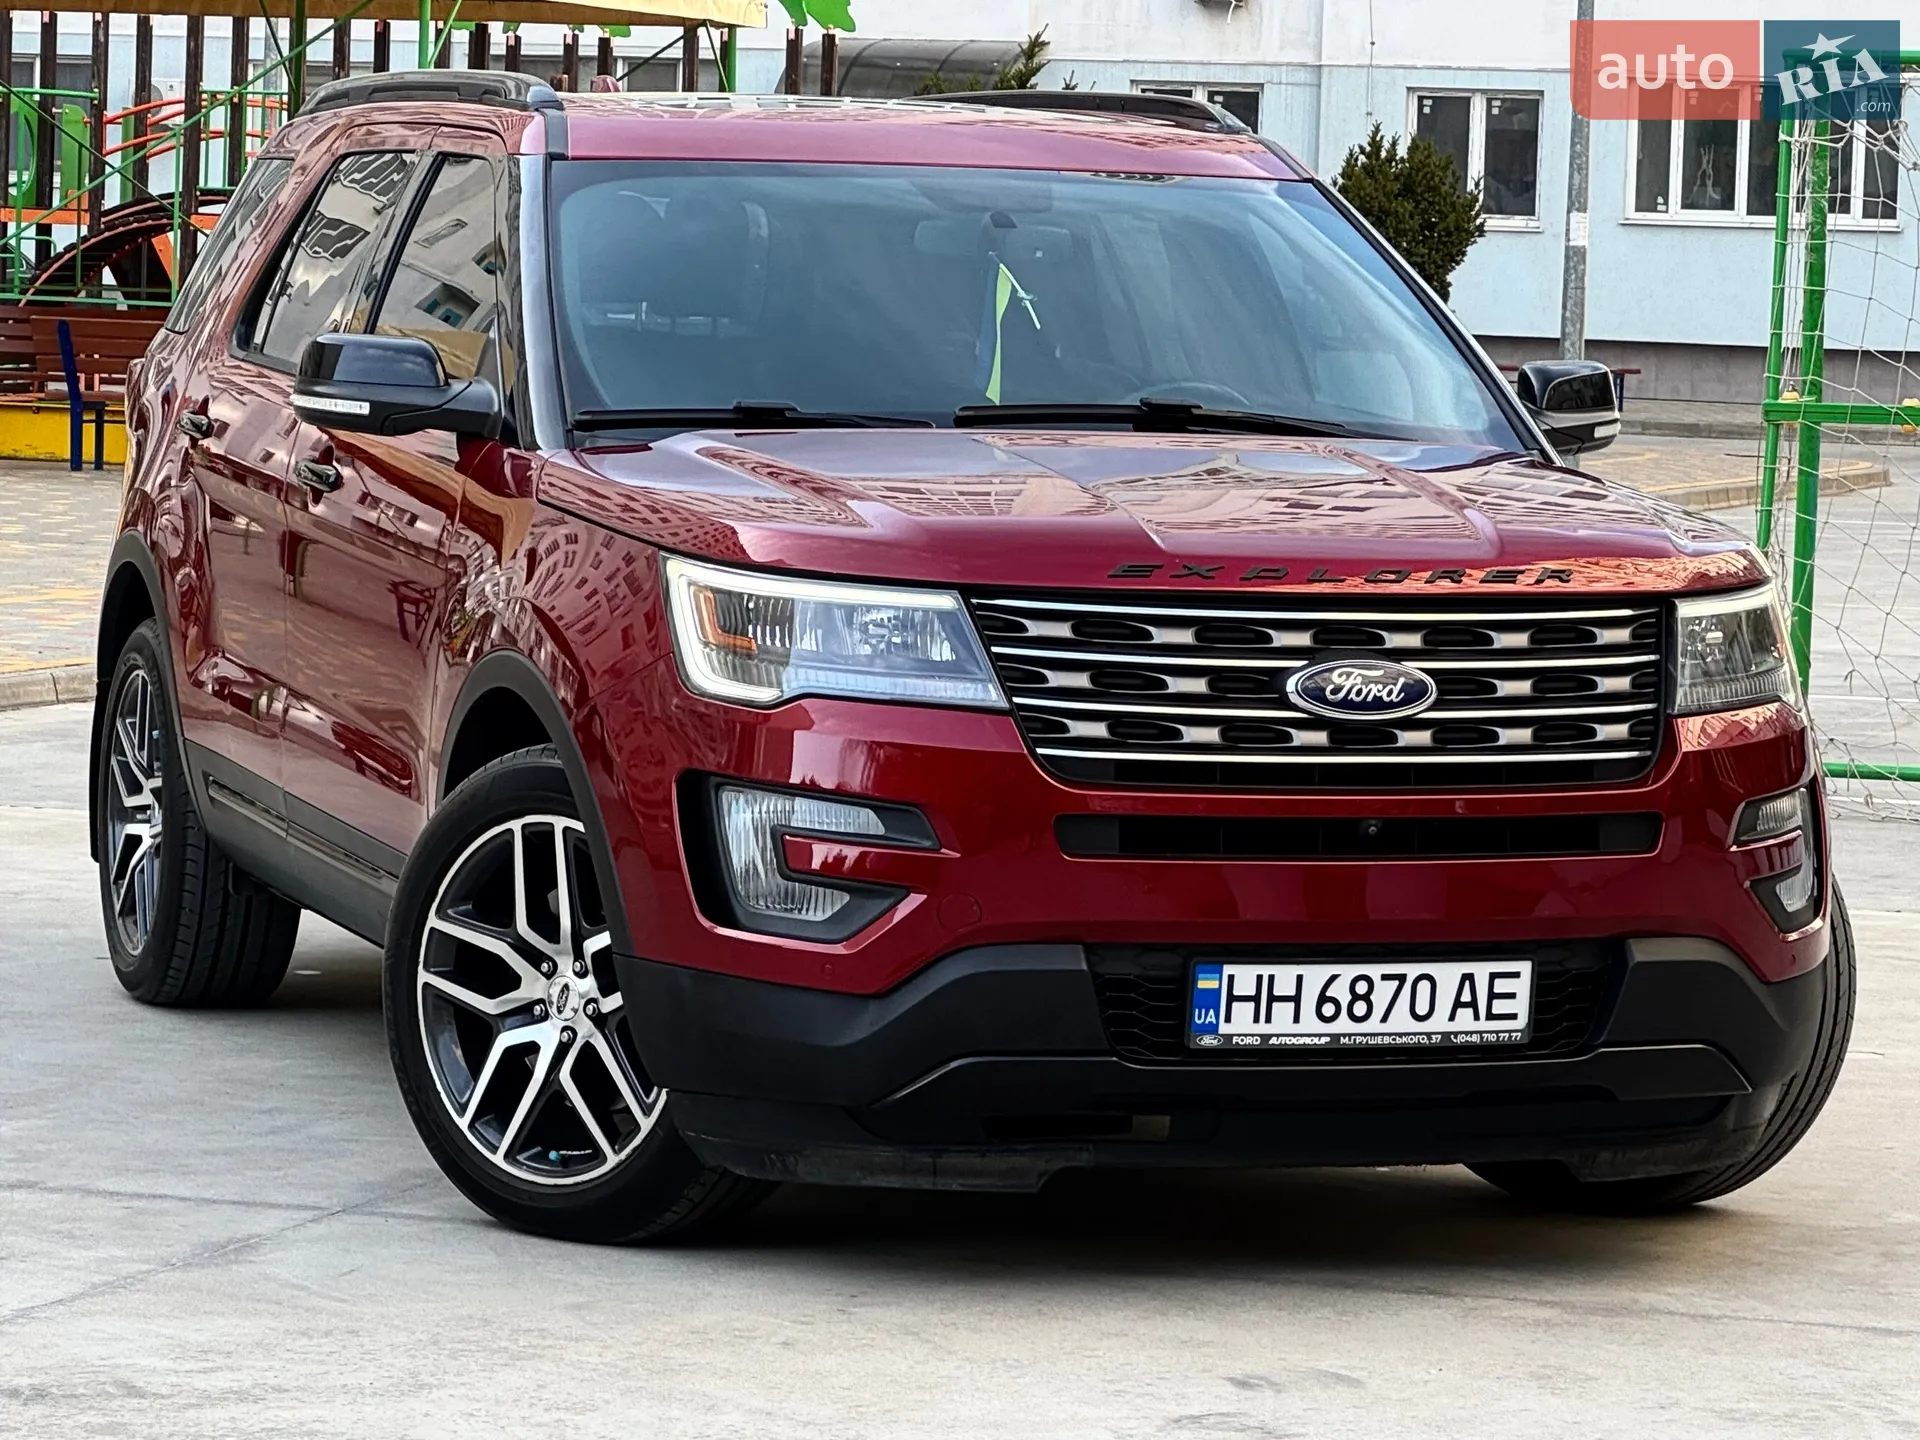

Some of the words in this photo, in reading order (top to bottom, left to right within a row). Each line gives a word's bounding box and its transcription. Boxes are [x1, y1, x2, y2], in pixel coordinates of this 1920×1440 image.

[1106, 562, 1575, 585] EXPLORER
[1325, 667, 1405, 703] Ford
[1223, 973, 1304, 1025] HH
[1314, 972, 1438, 1025] 6870
[1447, 971, 1522, 1022] AE
[1194, 1008, 1217, 1025] UA
[1232, 1035, 1261, 1045] FORD
[1268, 1036, 1331, 1045] AUTOGROUP
[1430, 1034, 1442, 1043] 37
[1457, 1033, 1480, 1043] (048)
[1482, 1033, 1497, 1042] 710
[1498, 1033, 1509, 1042] 77
[1510, 1032, 1522, 1041] 77
